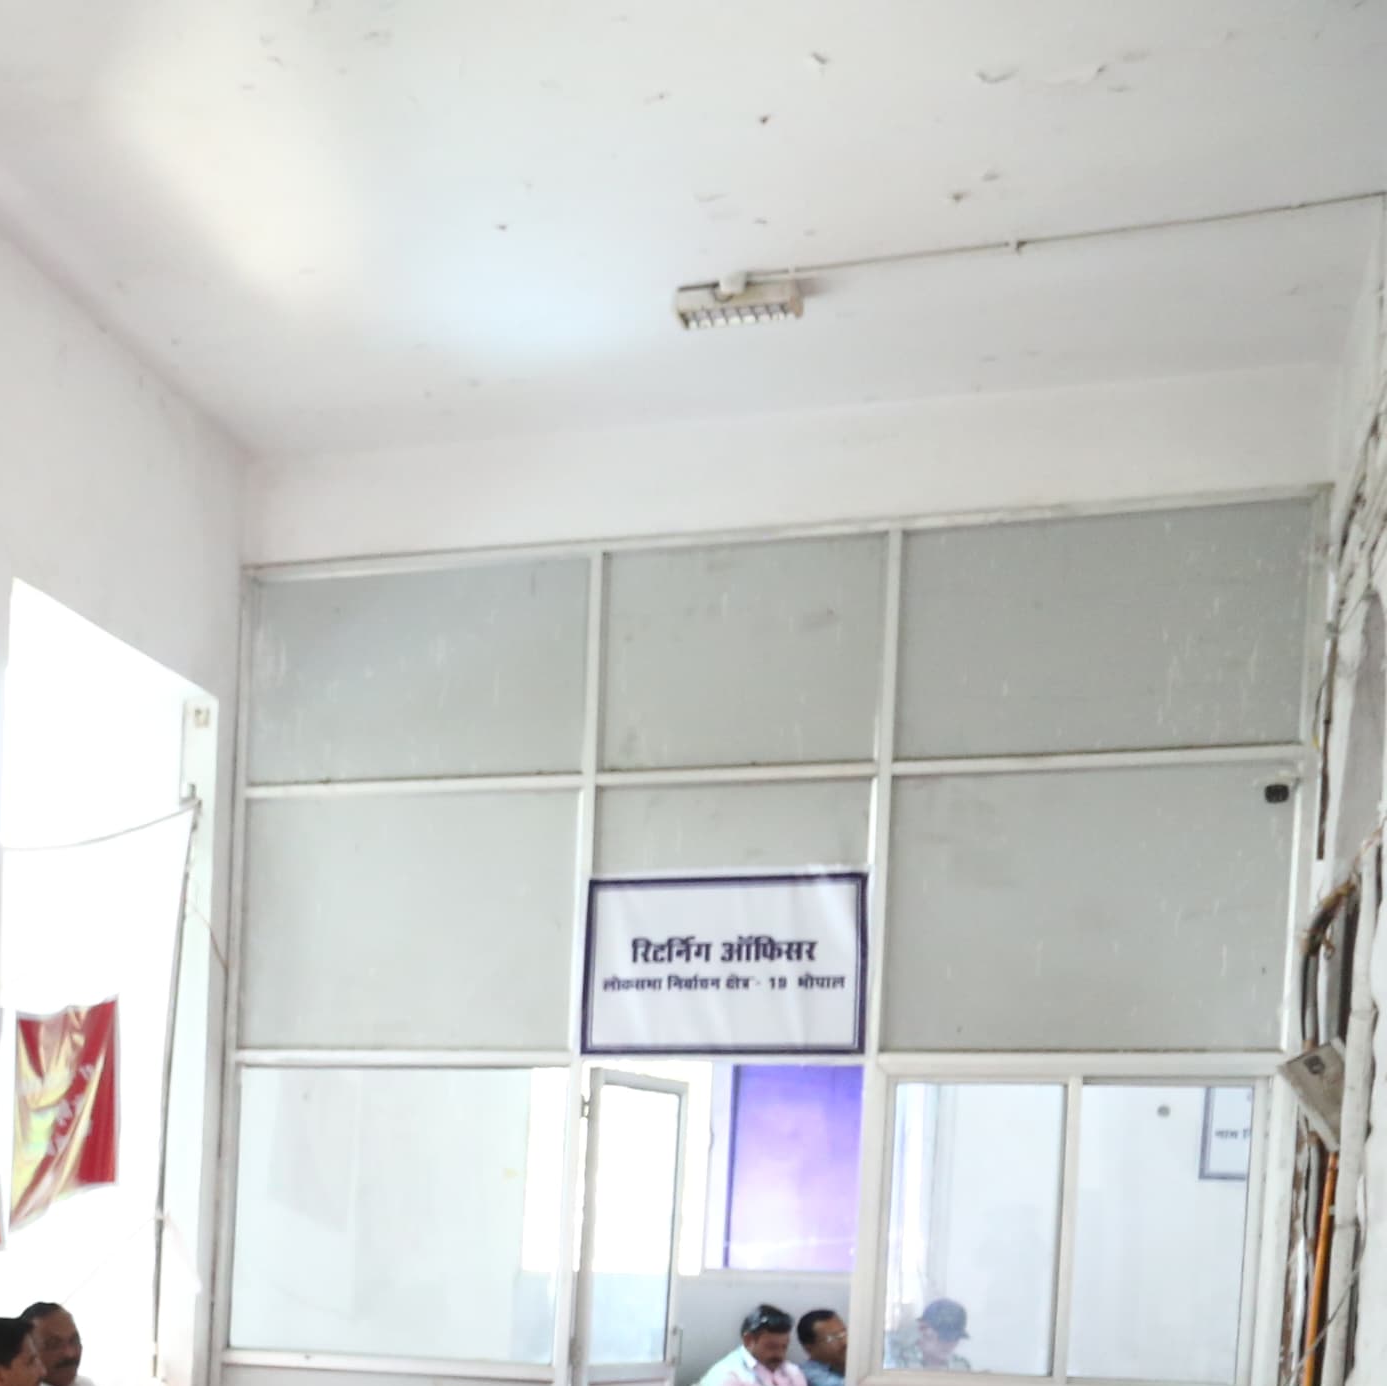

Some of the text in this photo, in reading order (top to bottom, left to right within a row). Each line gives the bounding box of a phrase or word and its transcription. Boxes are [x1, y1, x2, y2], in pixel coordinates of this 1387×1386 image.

[720, 935, 817, 963] ऑफिसर
[769, 976, 787, 990] 19
[797, 972, 845, 990] भोपाल
